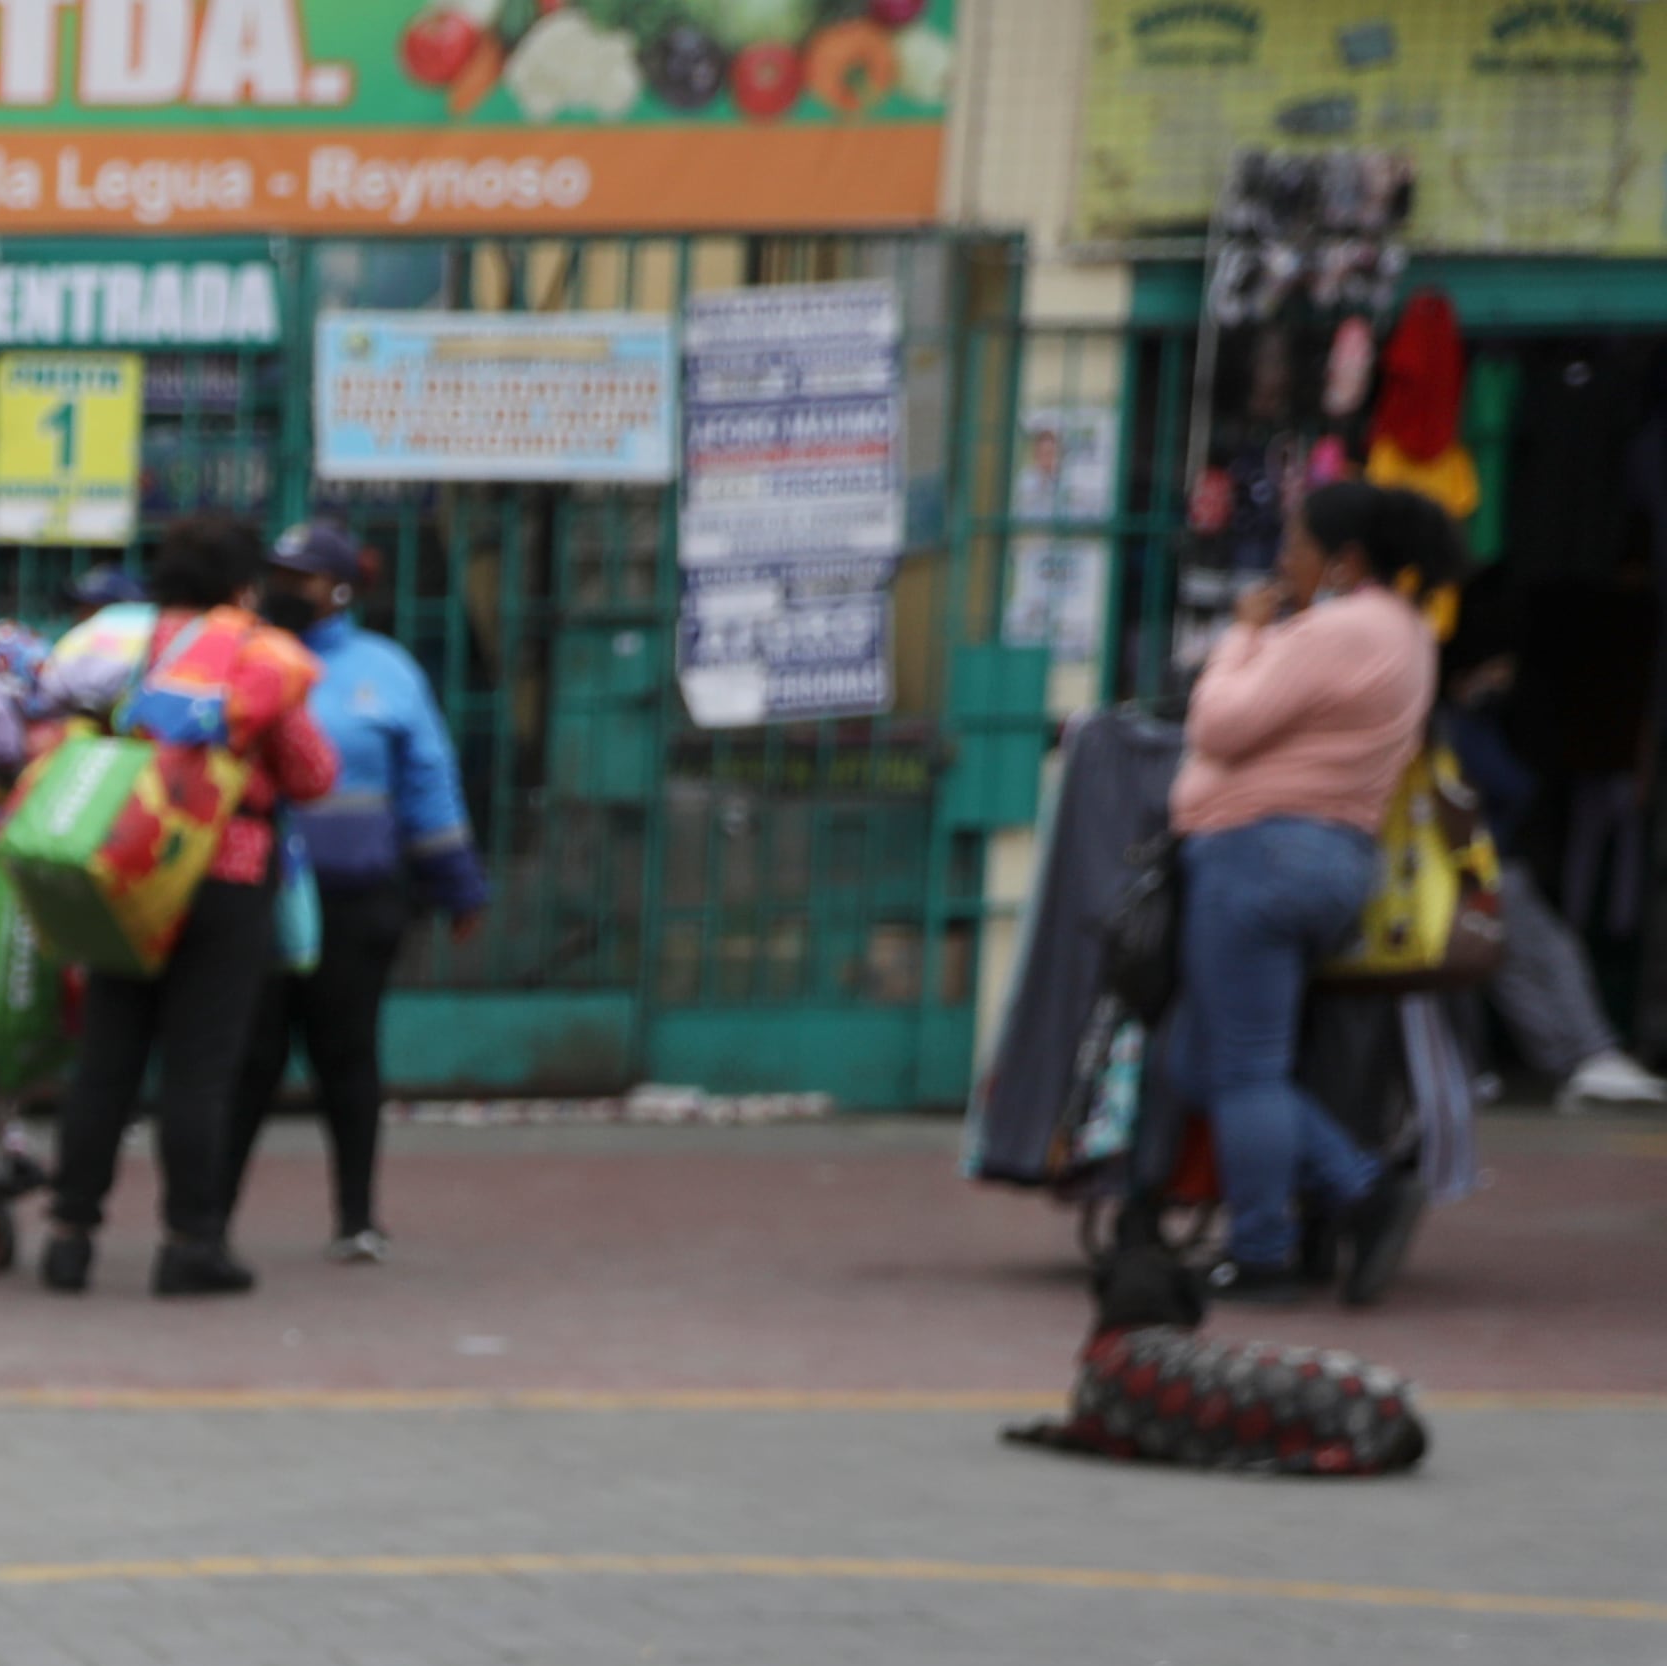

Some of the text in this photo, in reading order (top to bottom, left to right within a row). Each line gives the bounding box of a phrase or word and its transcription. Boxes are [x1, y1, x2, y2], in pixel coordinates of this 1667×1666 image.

[55, 146, 254, 222] Legua
[307, 146, 592, 224] Reynoso
[35, 400, 77, 470] 1
